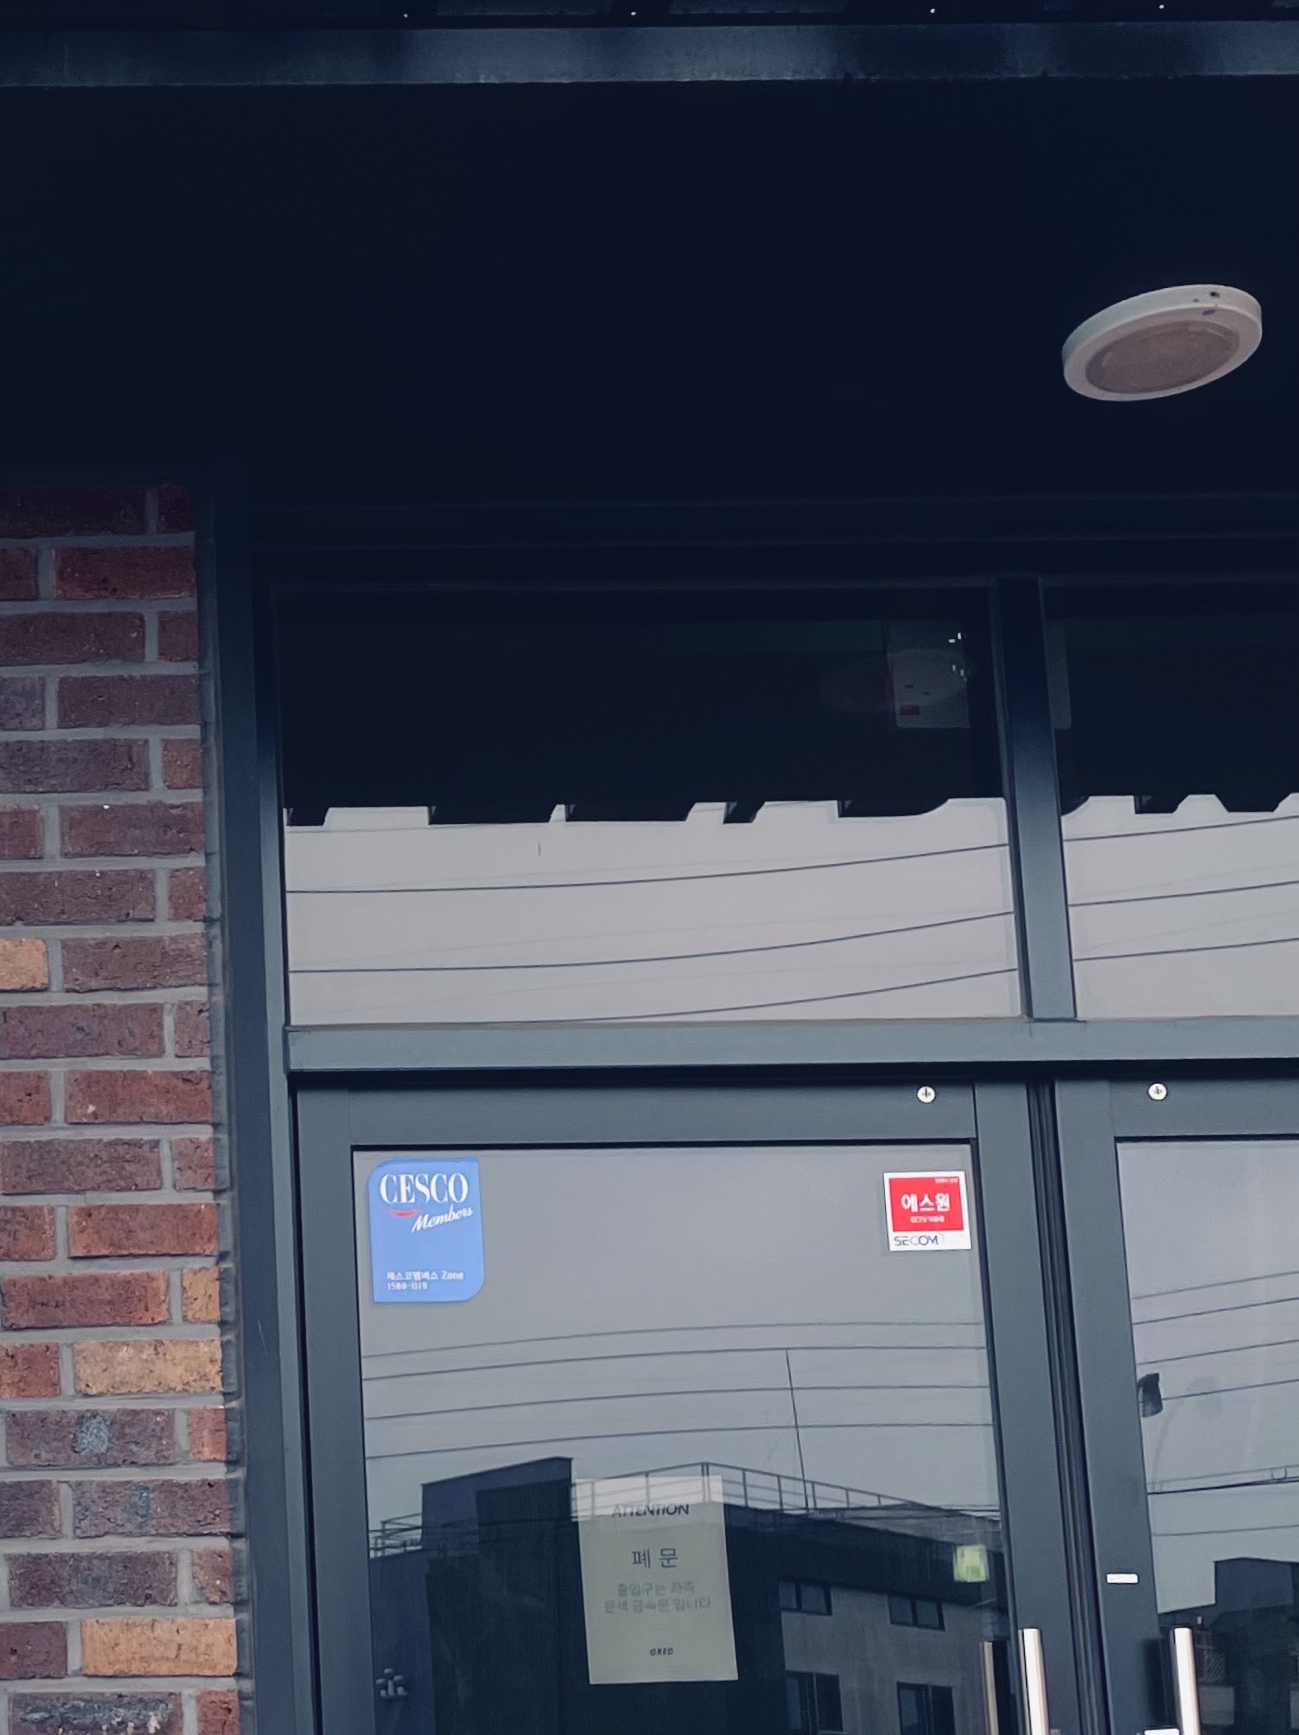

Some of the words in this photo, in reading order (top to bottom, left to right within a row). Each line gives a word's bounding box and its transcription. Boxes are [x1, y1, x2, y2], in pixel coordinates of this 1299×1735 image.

[379, 1173, 469, 1204] CESCO
[900, 1193, 951, 1213] 에스원
[411, 1205, 474, 1233] Members
[894, 1235, 939, 1246] SECOM
[612, 1503, 690, 1518] ATTENTION
[658, 1547, 679, 1568] 문
